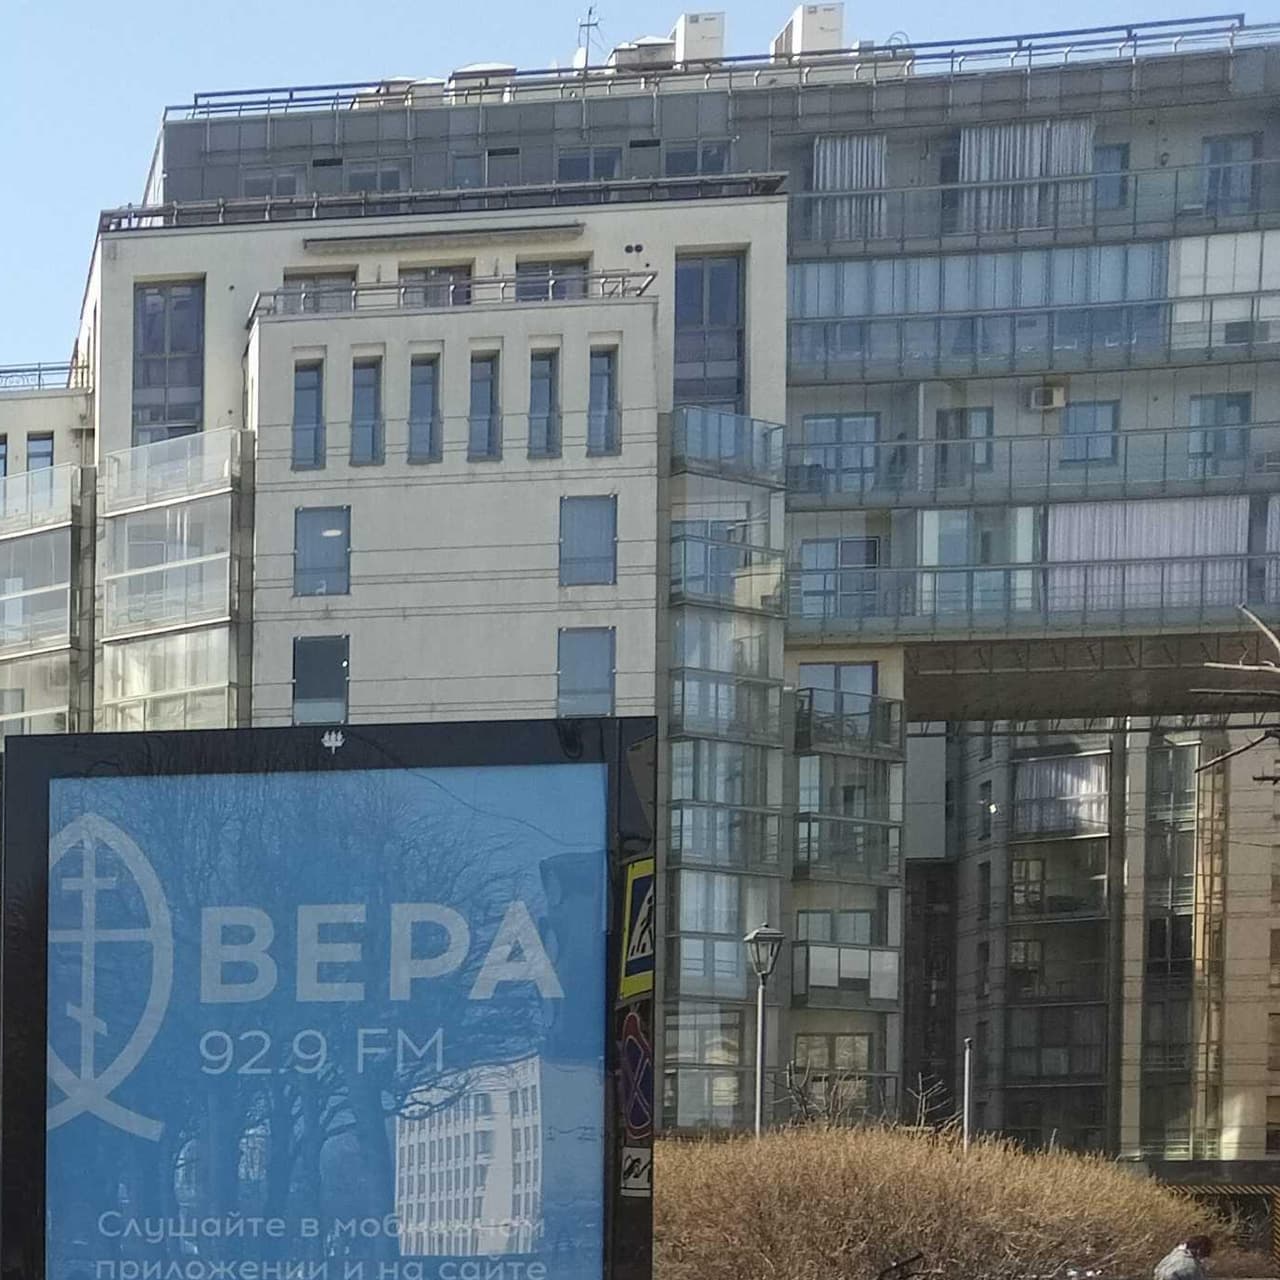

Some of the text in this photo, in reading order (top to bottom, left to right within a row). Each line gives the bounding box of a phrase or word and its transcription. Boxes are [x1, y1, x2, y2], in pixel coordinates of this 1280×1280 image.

[199, 899, 566, 1004] ВЕРА
[199, 1027, 444, 1075] 92.9 FM
[97, 1210, 545, 1244] Слушайте в мобом
[343, 1260, 364, 1280] и
